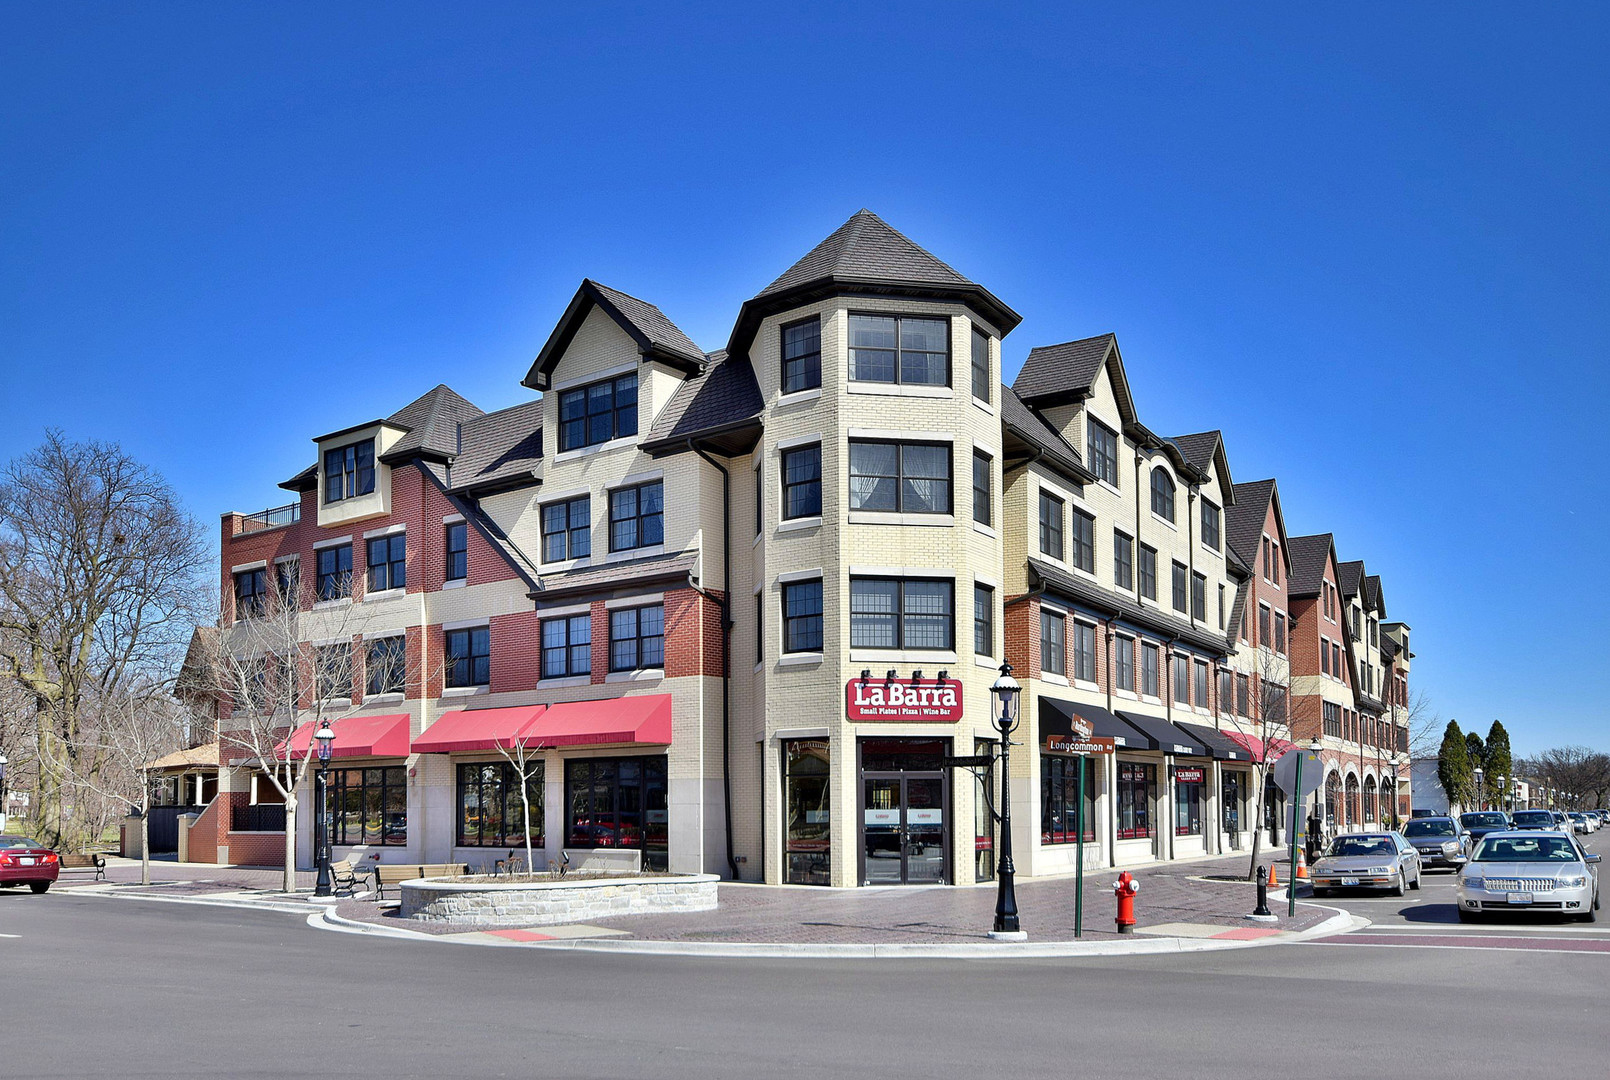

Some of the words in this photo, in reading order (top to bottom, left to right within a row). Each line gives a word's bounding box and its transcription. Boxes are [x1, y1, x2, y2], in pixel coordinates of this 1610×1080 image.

[854, 682, 885, 706] La
[887, 683, 957, 706] Barra
[860, 707, 877, 715] Small
[1050, 740, 1104, 752] Longcommon
